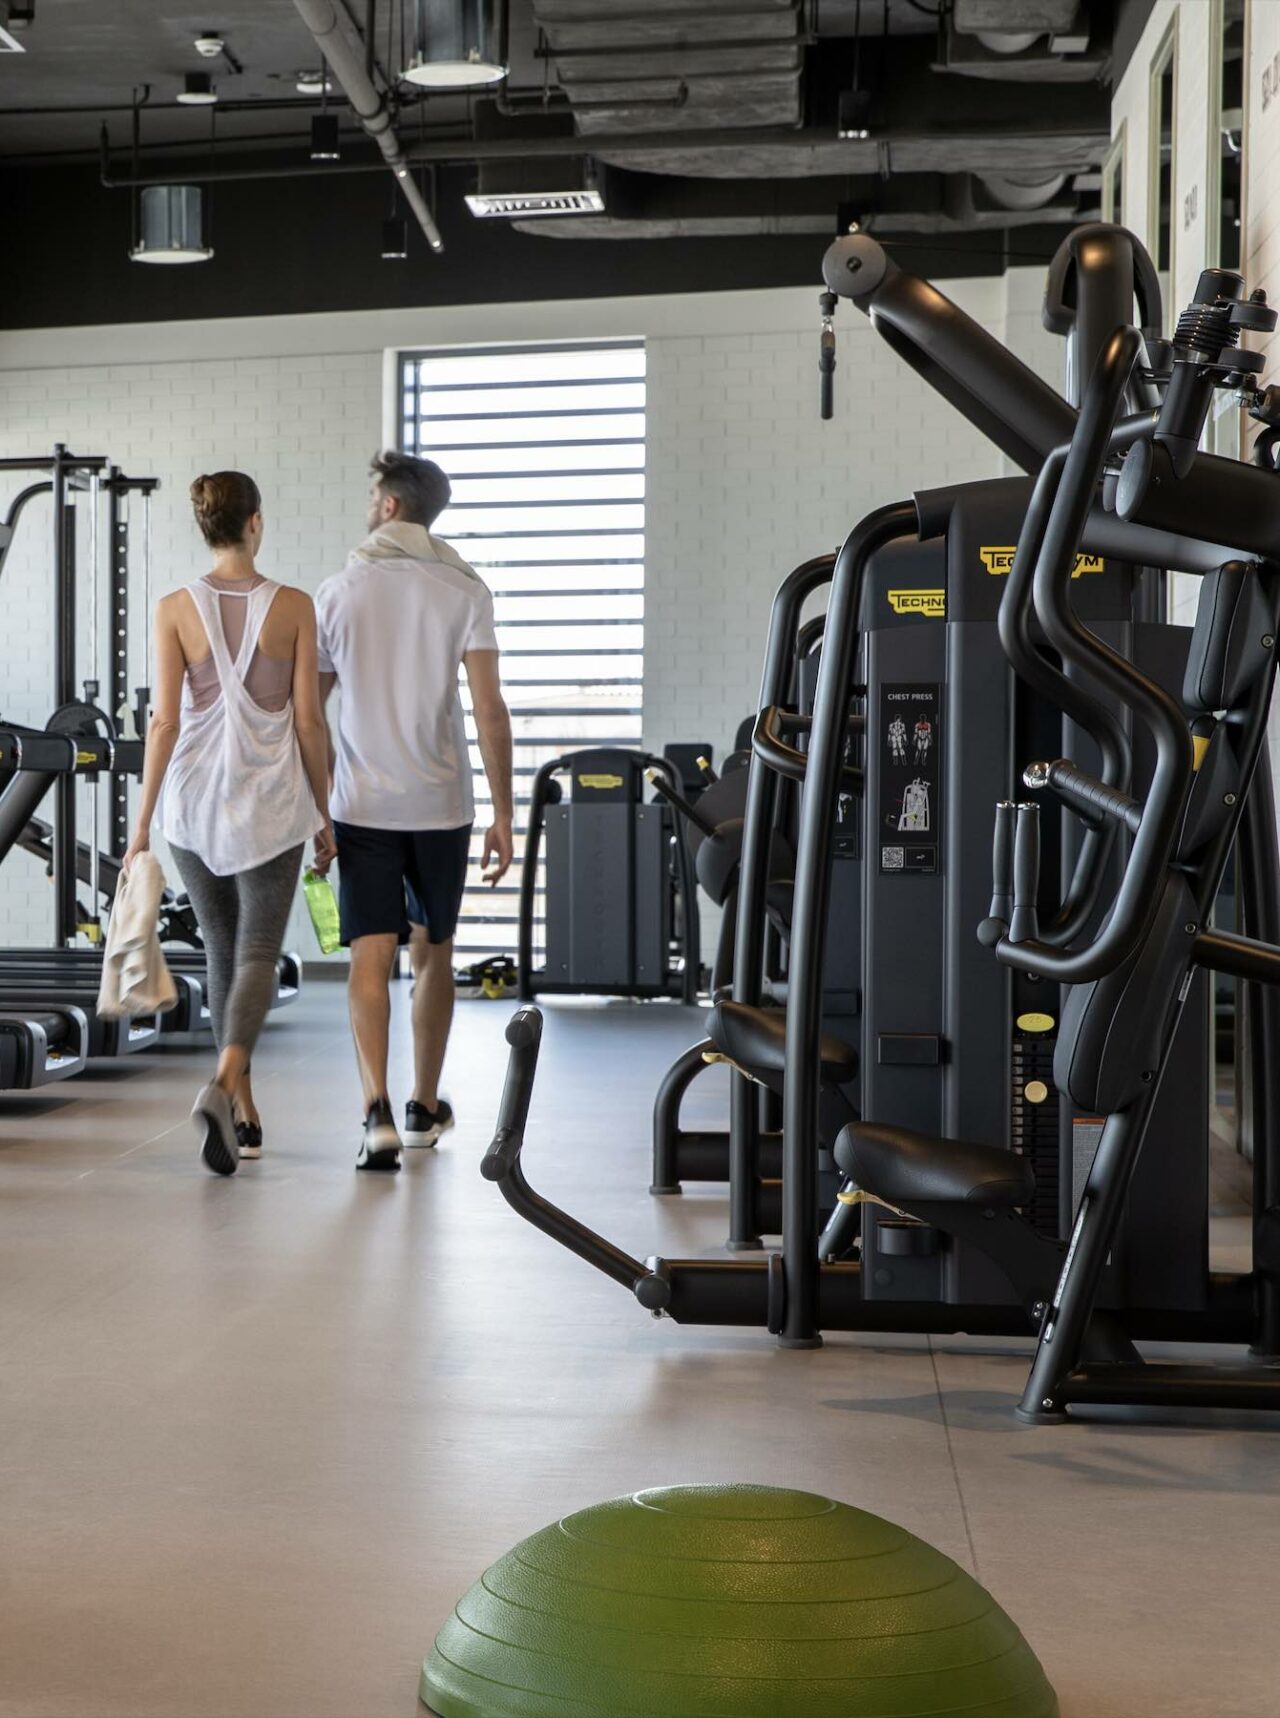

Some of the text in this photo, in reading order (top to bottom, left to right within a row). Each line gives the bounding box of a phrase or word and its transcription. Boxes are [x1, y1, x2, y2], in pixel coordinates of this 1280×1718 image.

[889, 592, 945, 611] TECHN
[887, 693, 933, 701] CHEST PRESS
